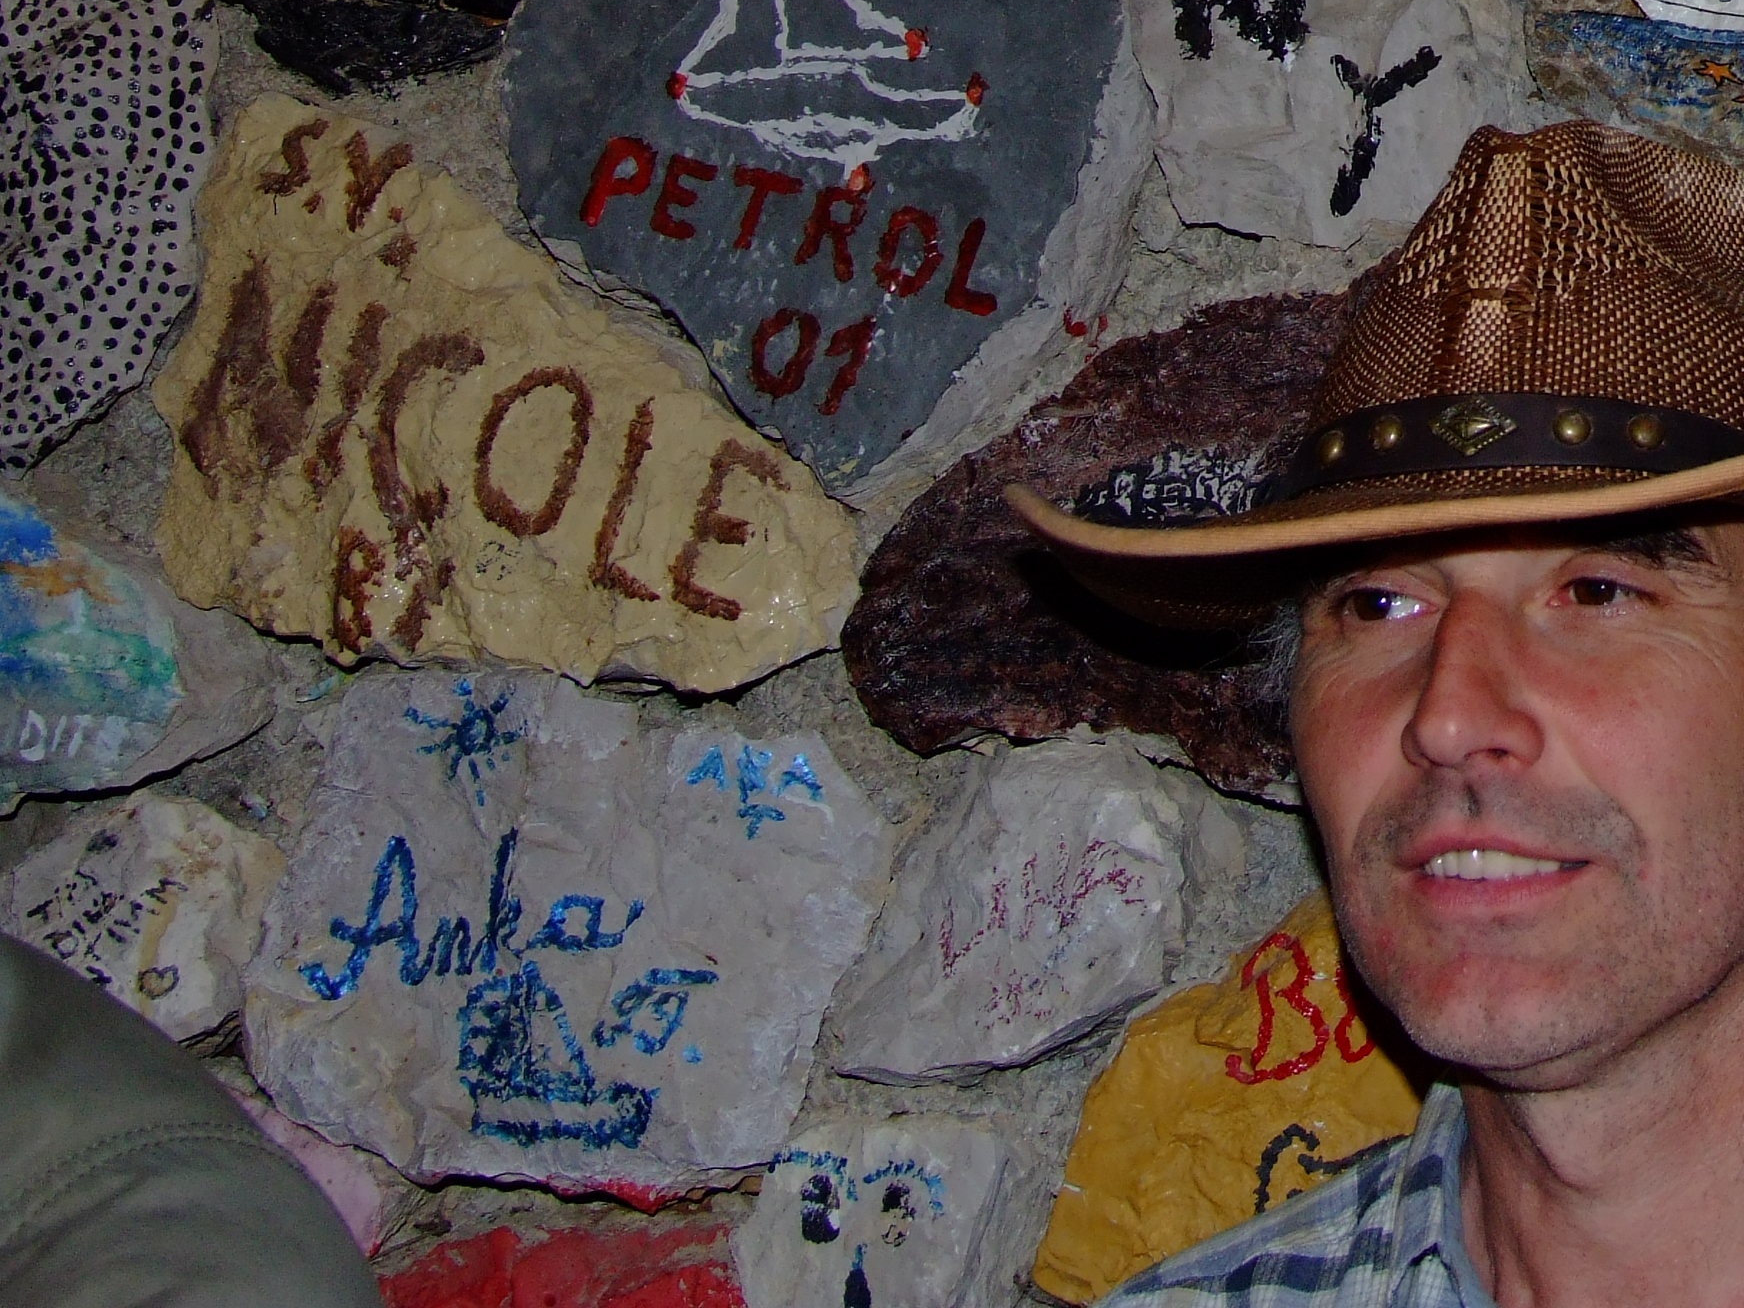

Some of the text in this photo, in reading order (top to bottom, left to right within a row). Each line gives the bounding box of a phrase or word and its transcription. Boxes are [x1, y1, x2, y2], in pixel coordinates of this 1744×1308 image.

[578, 136, 999, 317] PETROL
[181, 250, 790, 623] NICOLE
[749, 306, 878, 416] 01
[298, 825, 646, 1002] Anka
